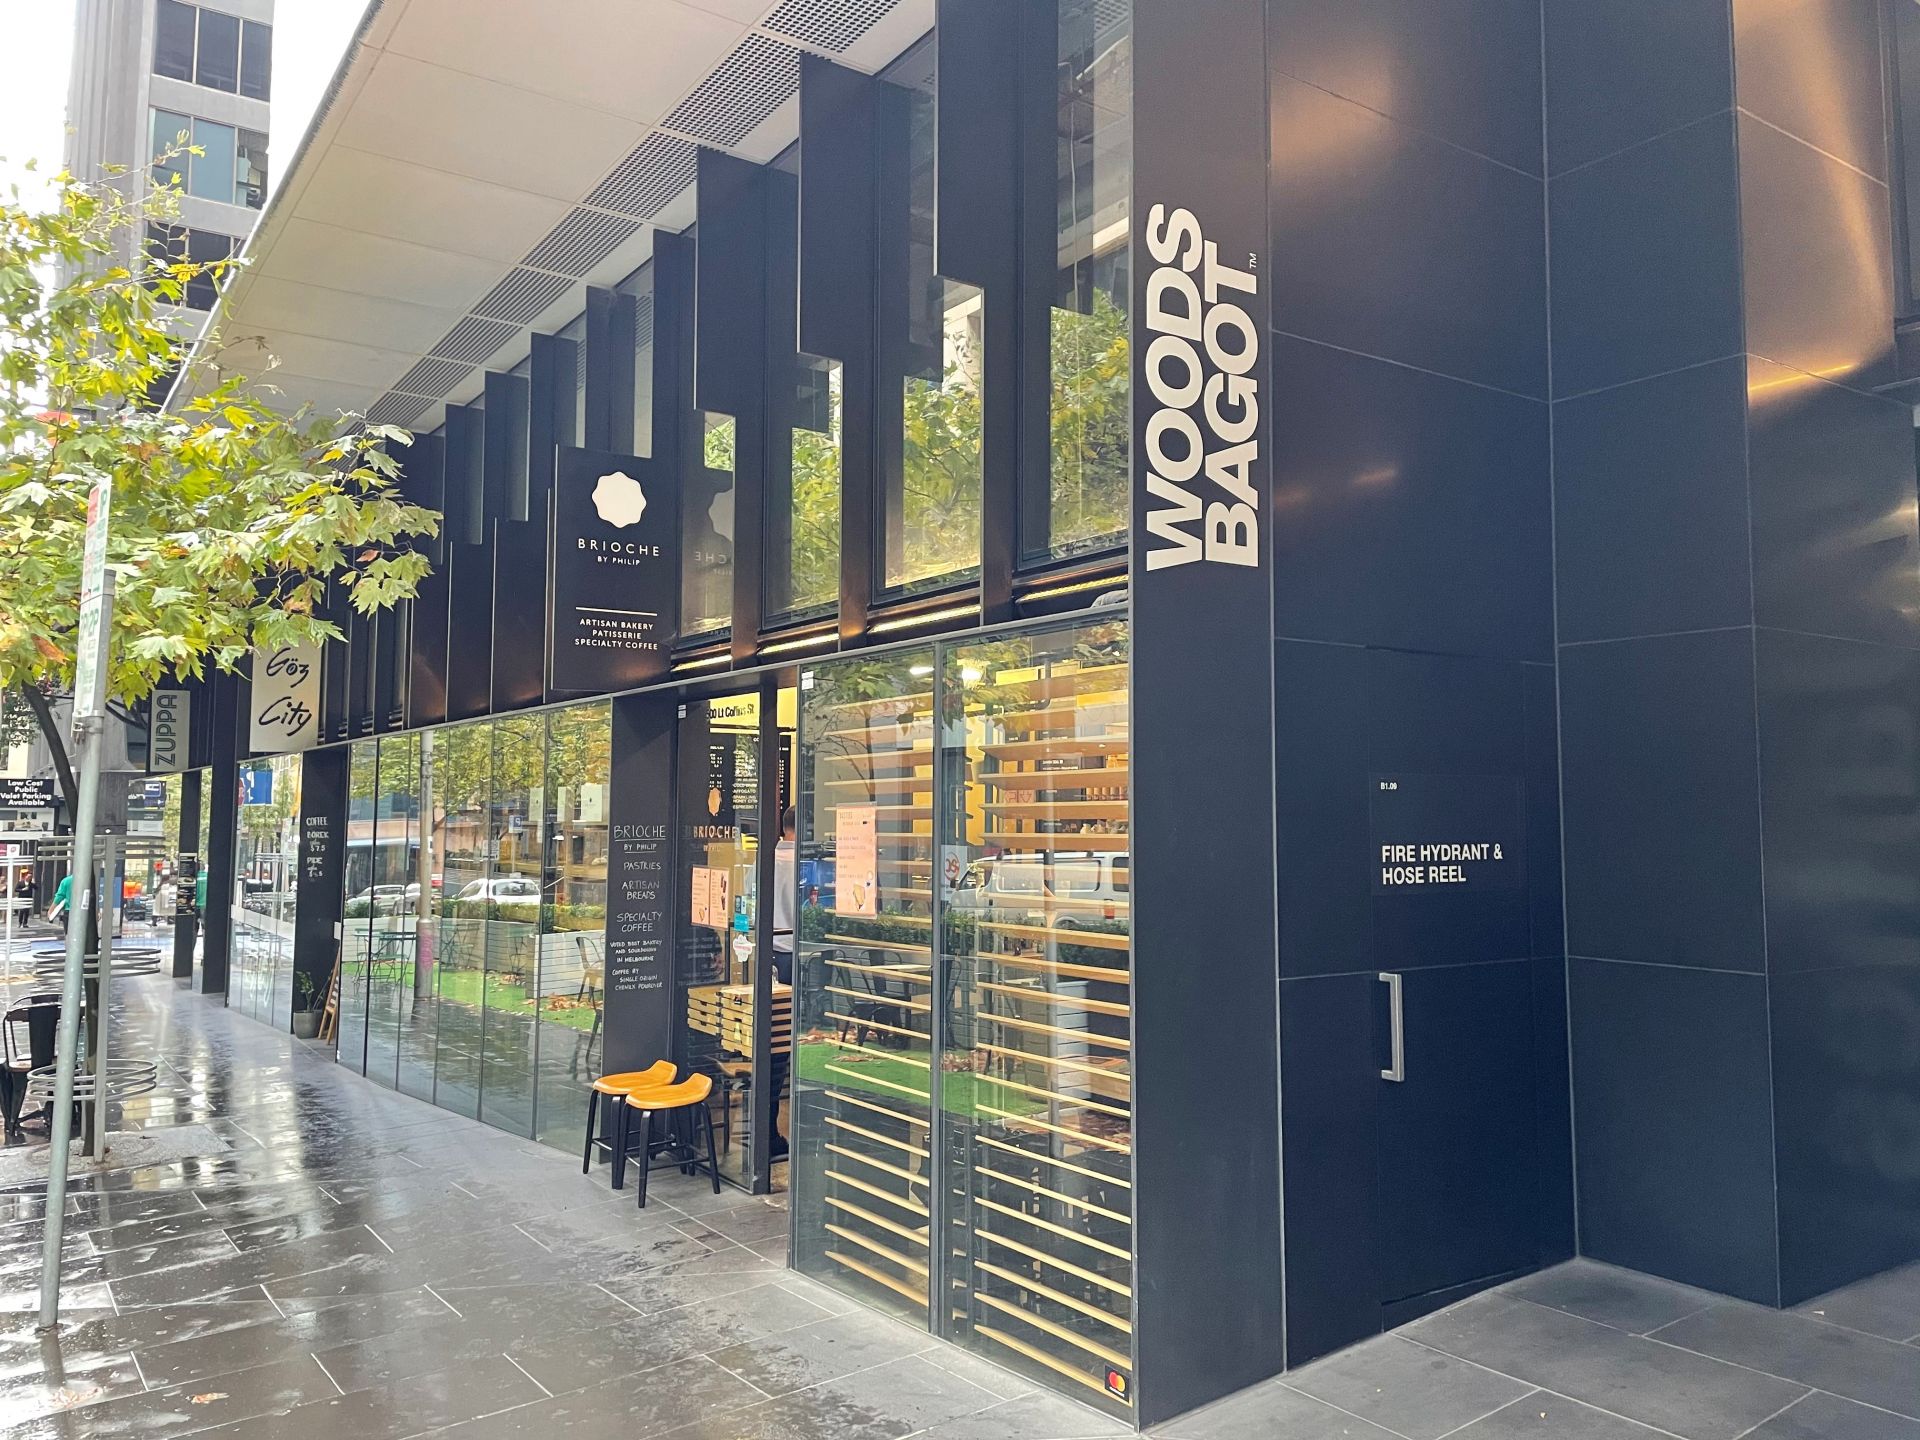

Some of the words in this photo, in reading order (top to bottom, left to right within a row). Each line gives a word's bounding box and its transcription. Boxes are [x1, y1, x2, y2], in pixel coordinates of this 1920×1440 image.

[1145, 203, 1203, 571] WOODS
[1203, 240, 1259, 567] BAGOT
[578, 538, 660, 557] BRIOCHE
[597, 555, 608, 563] BY
[612, 557, 640, 566] PHILIP
[579, 618, 618, 628] ARTISAN
[620, 621, 654, 630] BAKERY
[592, 629, 641, 640] PATISSERIE
[574, 638, 622, 648] SPECIALTY
[625, 641, 658, 650] COFFEE
[258, 696, 313, 737] City
[154, 694, 178, 767] ZUPPA
[22, 792, 52, 800] Parking
[613, 825, 666, 839] BRIOCHE
[693, 825, 736, 839] BRIOCHE
[624, 843, 632, 851] BY
[636, 843, 657, 851] PHILIP
[1382, 845, 1416, 862] FIRE
[1420, 843, 1490, 862] HYDRANT
[1493, 843, 1503, 860] &
[623, 861, 661, 871] PASTRIES
[1382, 866, 1425, 885] HOSE
[1428, 865, 1467, 883] REEL
[621, 880, 660, 890] ARTISAN
[626, 890, 656, 900] BREADS
[616, 911, 662, 922] SPECIALTY
[621, 922, 654, 932] COFFEE
[624, 955, 654, 963] MELBOURNE
